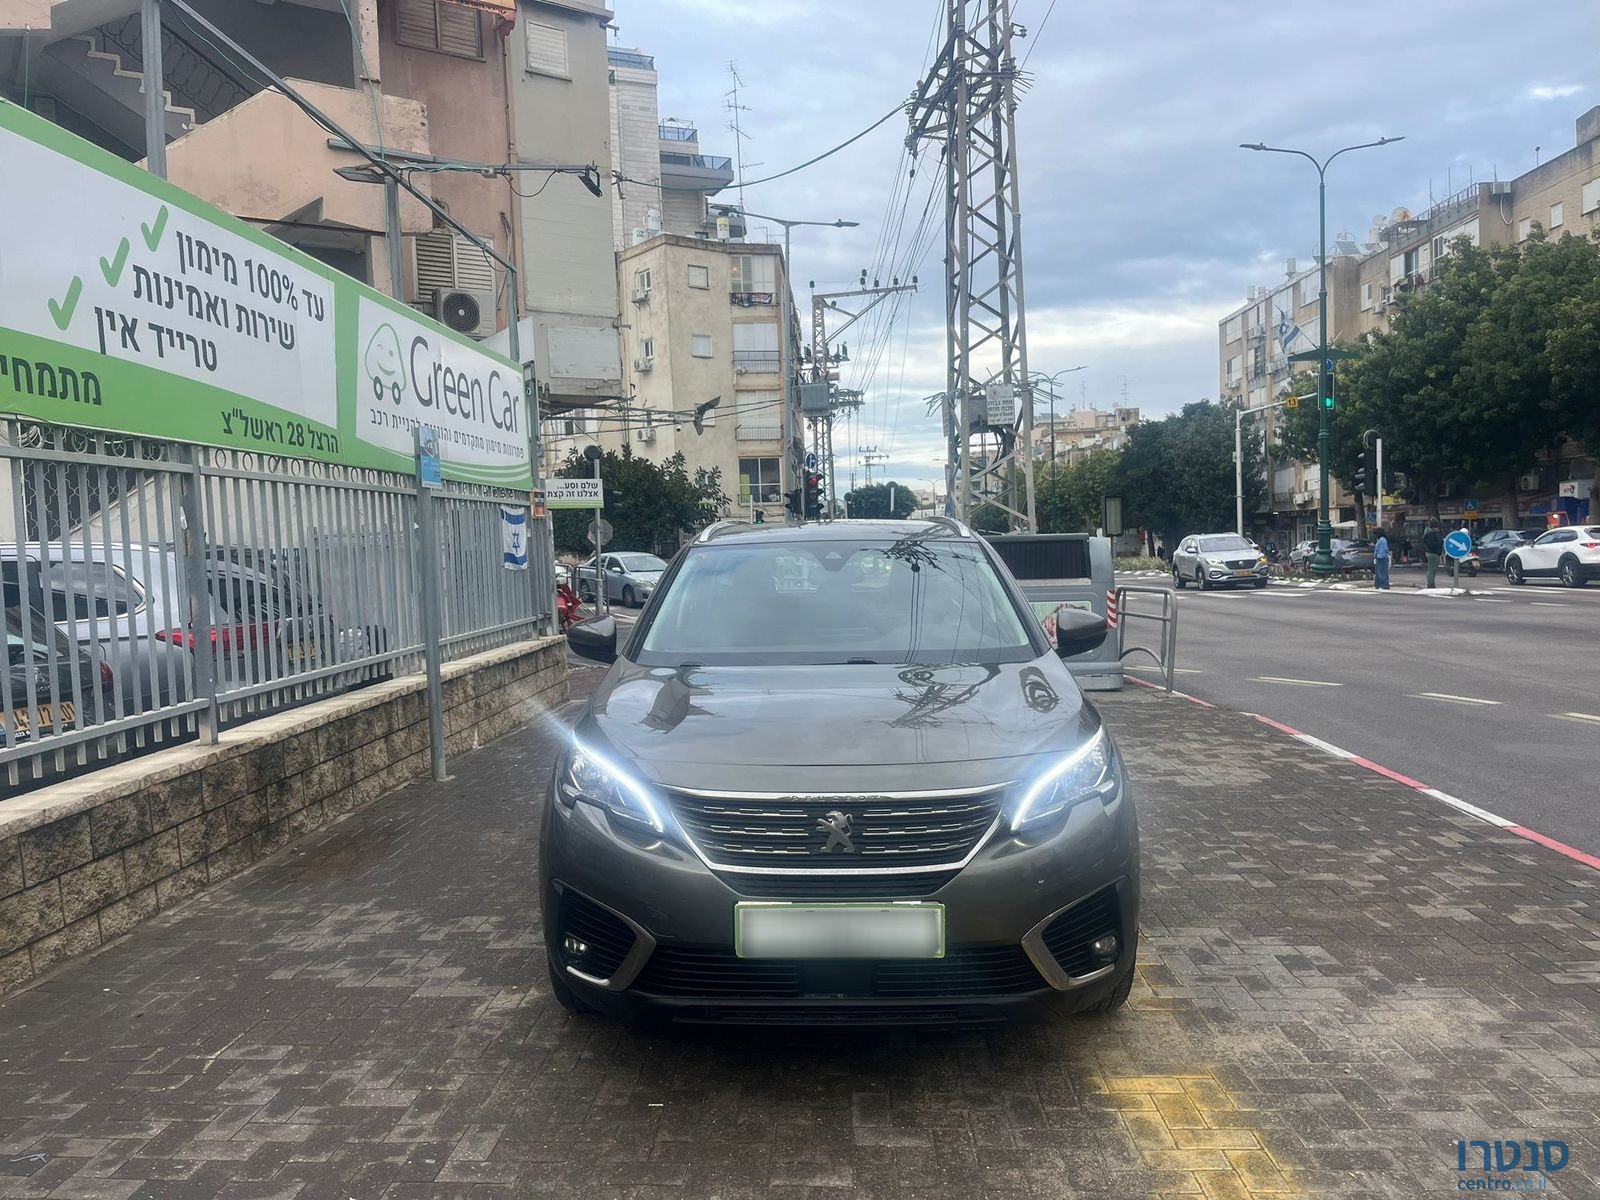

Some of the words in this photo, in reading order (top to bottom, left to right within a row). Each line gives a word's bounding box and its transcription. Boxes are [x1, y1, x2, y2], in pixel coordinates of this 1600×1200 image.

[176, 230, 238, 286] מימון
[133, 264, 229, 329] ואמינות
[244, 258, 298, 311] 100%
[302, 288, 324, 322] עד
[94, 306, 141, 355] אין
[235, 303, 295, 351] שירות
[148, 321, 218, 372] טרייד
[410, 335, 485, 424] Green
[488, 370, 519, 433] Car
[370, 408, 388, 427] רכב
[1288, 398, 1297, 406] 13
[287, 421, 304, 448] 28
[307, 424, 339, 454] הרצל
[454, 430, 484, 451] מתקדמים
[547, 490, 564, 499] קצת
[577, 490, 599, 498] אצלנו
[581, 481, 598, 489] שלם
